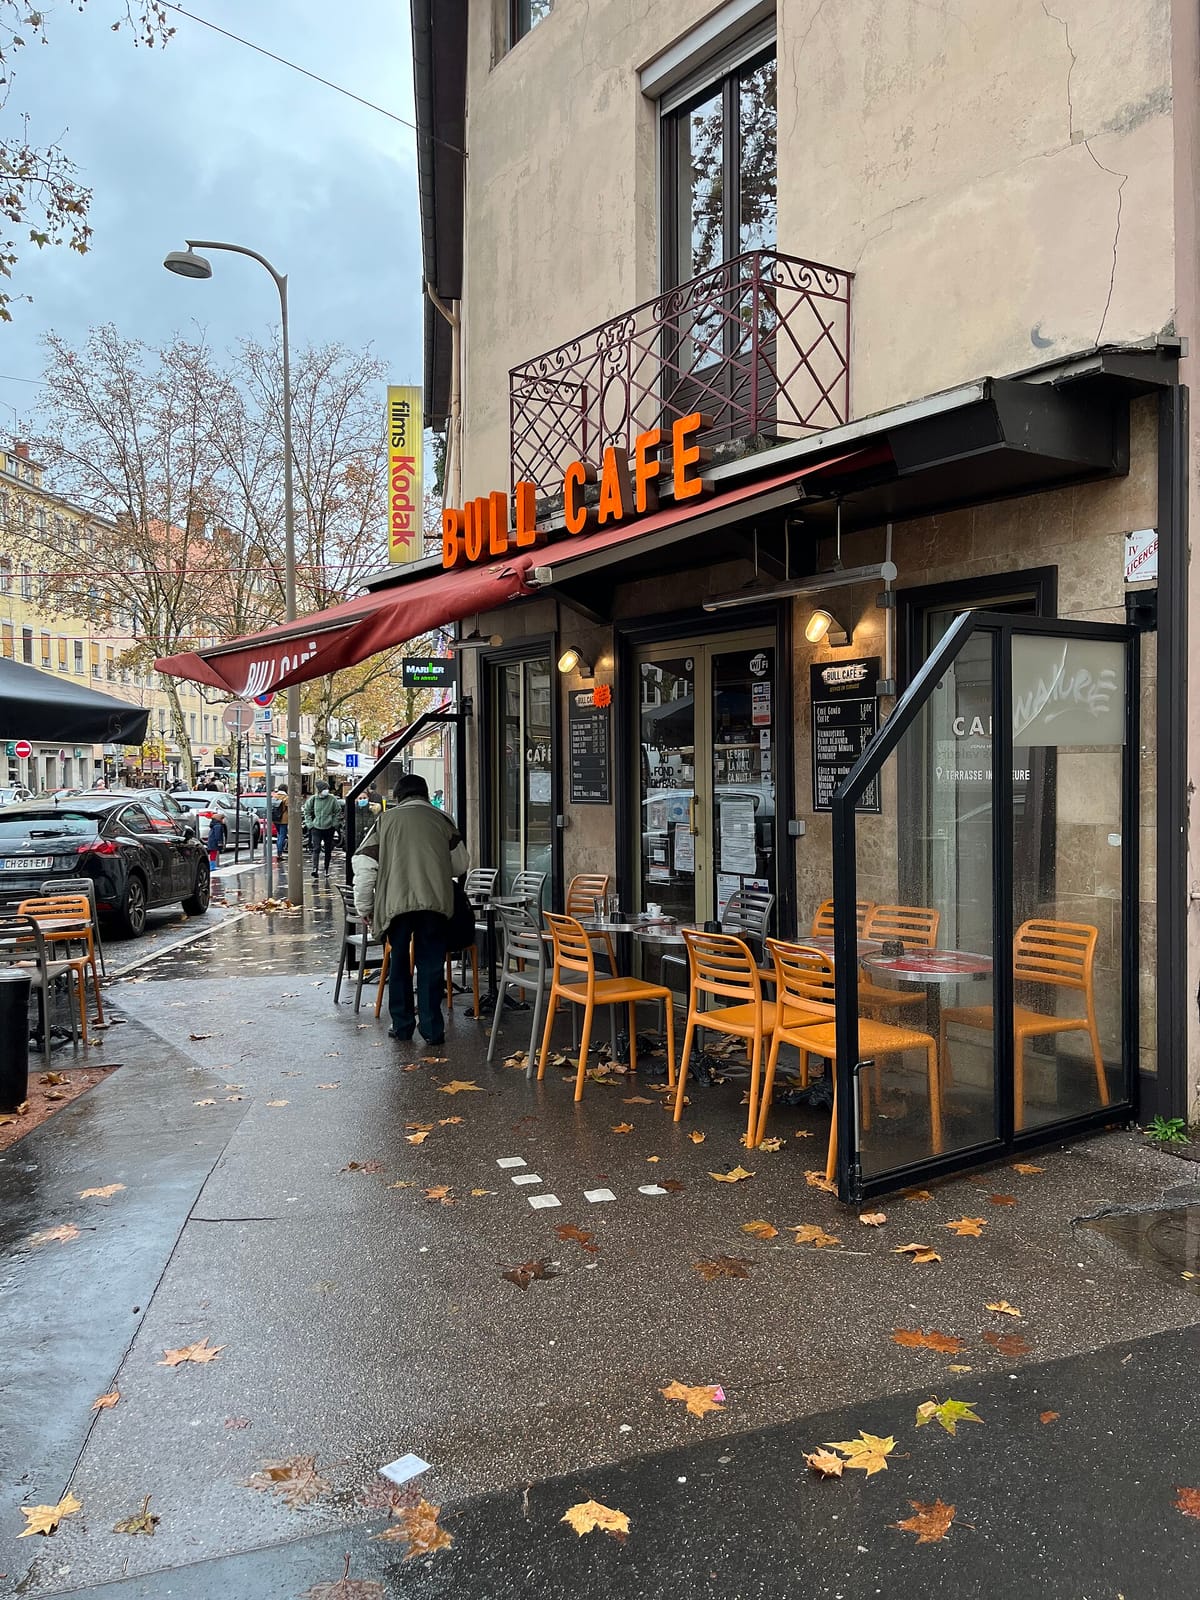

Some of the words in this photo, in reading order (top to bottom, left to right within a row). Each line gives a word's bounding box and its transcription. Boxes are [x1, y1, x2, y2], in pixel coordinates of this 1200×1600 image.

[391, 400, 410, 448] films
[391, 455, 416, 547] Kodak
[442, 481, 537, 569] BULL
[1126, 540, 1159, 576] LICENCE
[1128, 545, 1139, 556] IV
[826, 671, 840, 680] BULL
[952, 715, 992, 736] CA
[946, 769, 983, 781] TERRASSE
